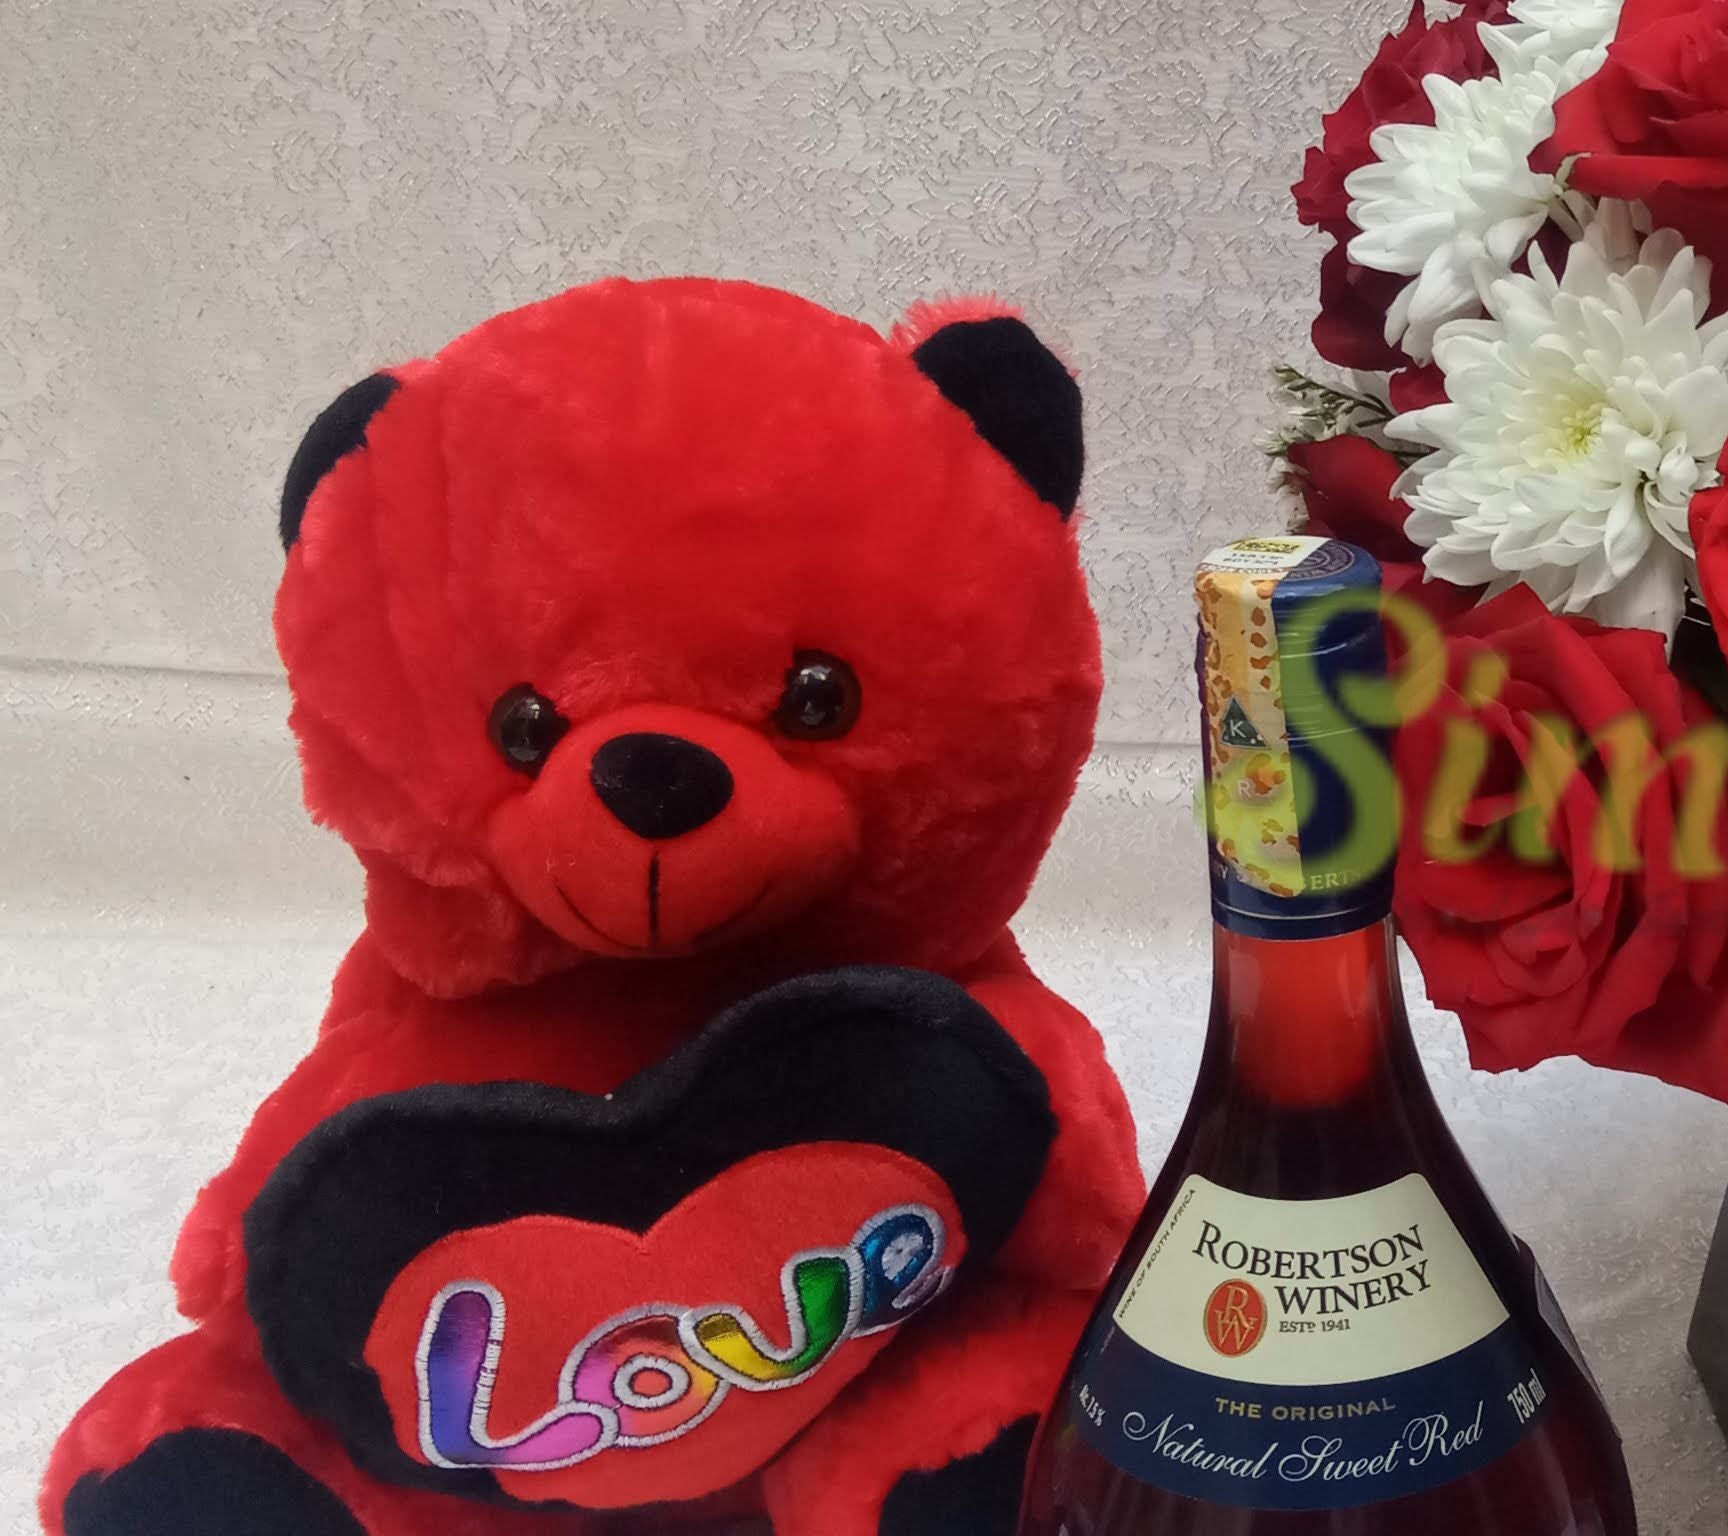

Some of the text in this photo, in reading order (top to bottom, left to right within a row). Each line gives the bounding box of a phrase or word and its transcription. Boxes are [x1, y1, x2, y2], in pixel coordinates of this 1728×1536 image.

[1119, 1188, 1196, 1319] WINE OF SOUTH AFRICA
[1192, 1219, 1425, 1280] ROBERTSON
[1274, 1259, 1431, 1315] WINERY
[1321, 1318, 1351, 1332] 1941
[1215, 1397, 1397, 1421] THE ORIGINAL
[1506, 1367, 1547, 1424] 750 ml
[1123, 1400, 1484, 1482] Natural Sweet Red
